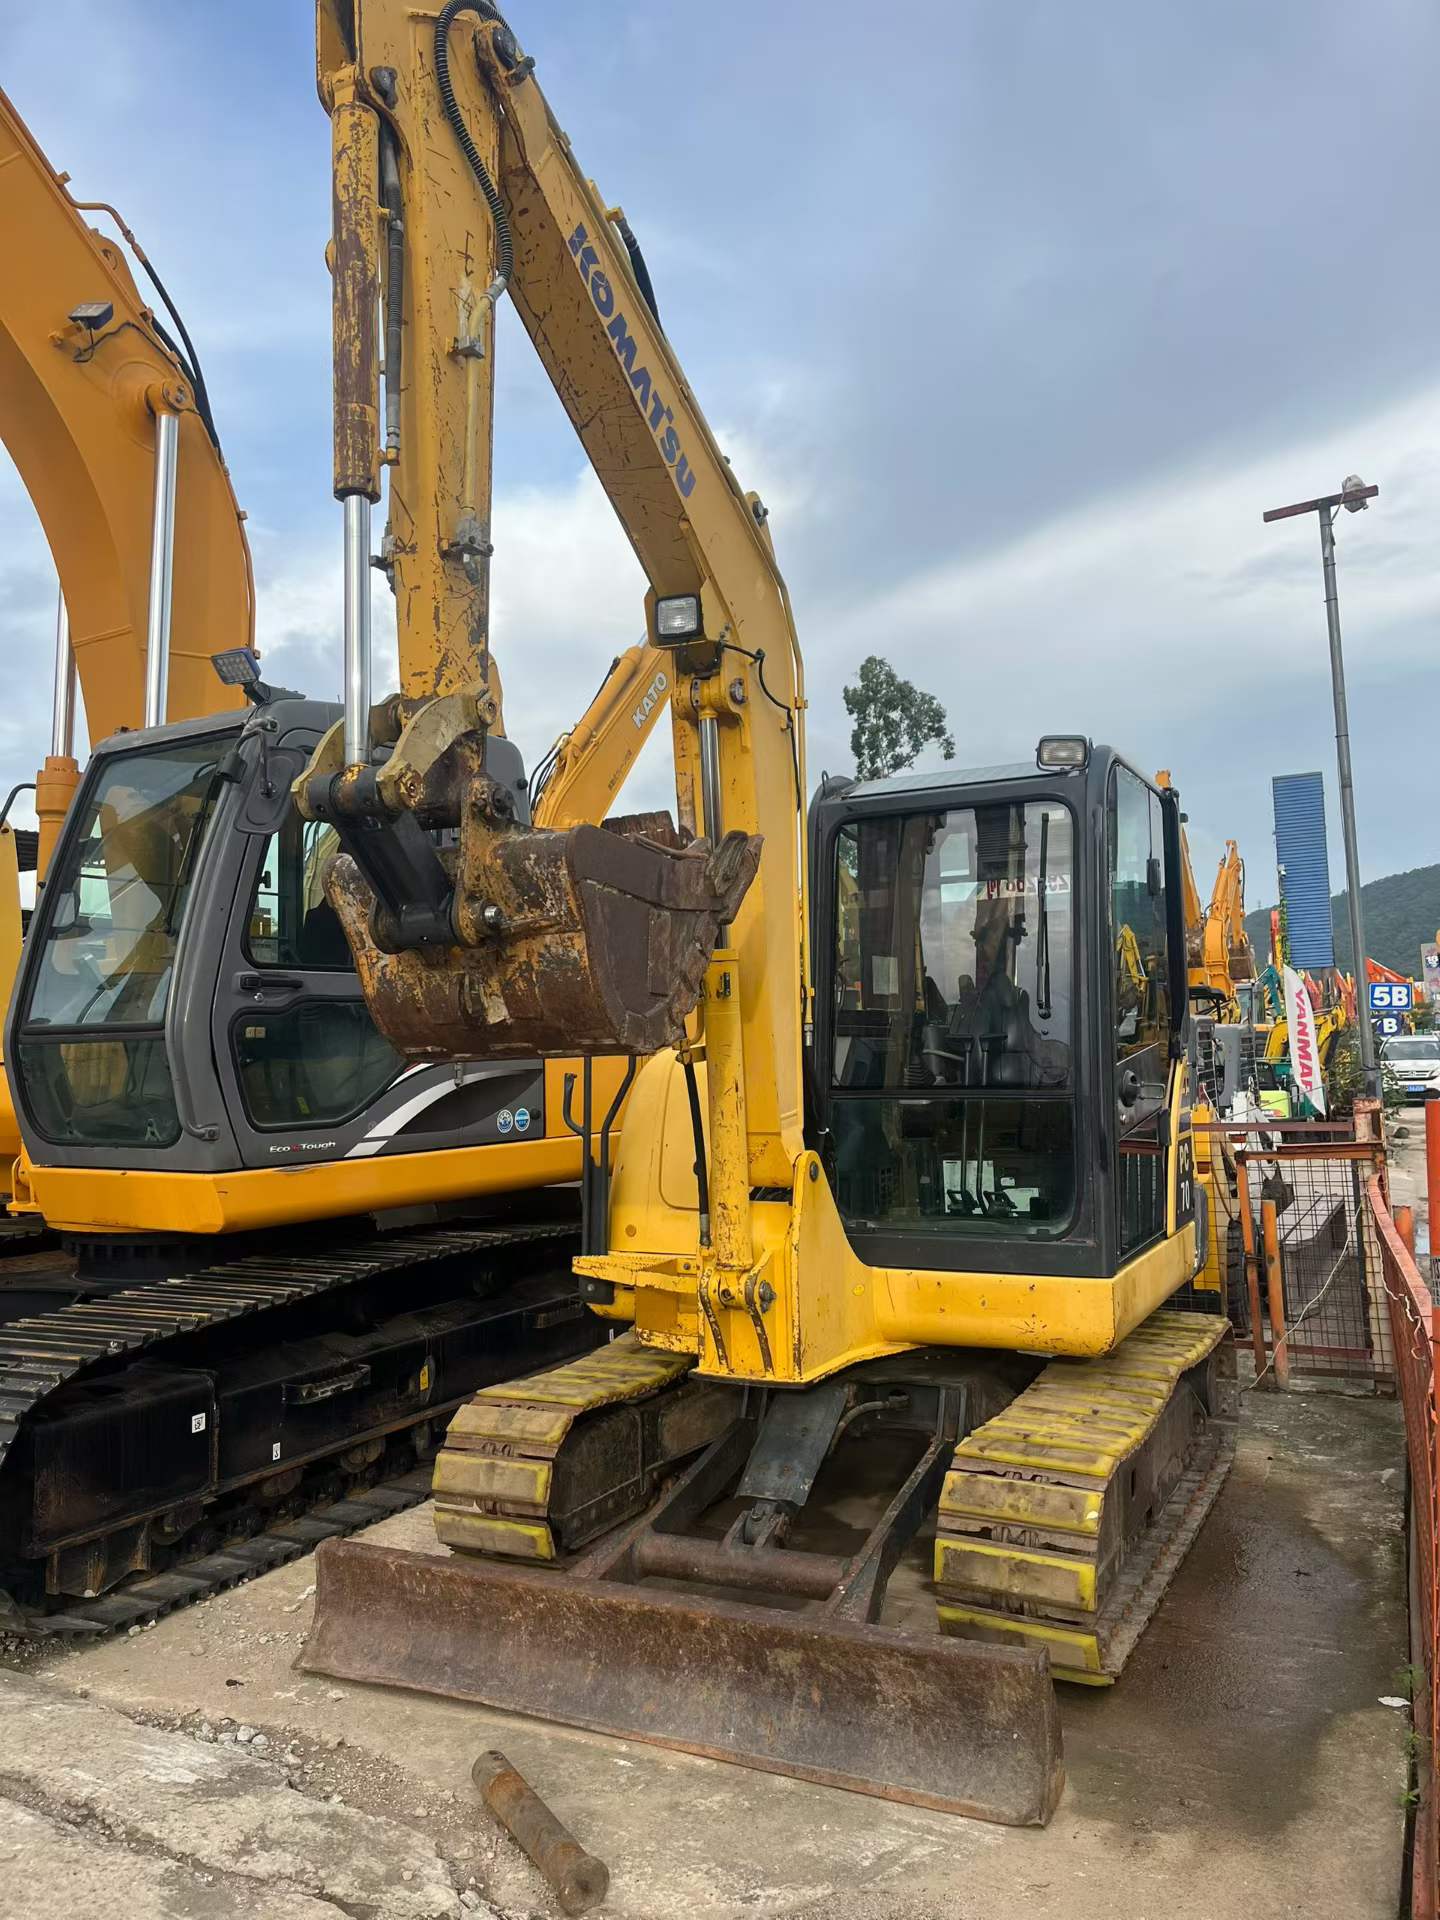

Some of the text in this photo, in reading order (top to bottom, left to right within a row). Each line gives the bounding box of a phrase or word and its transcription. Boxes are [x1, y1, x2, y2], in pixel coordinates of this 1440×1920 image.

[568, 222, 696, 498] KOMATSU
[632, 672, 667, 729] KATO
[1373, 986, 1409, 1007] 5B
[270, 1145, 290, 1153] Eco
[1179, 1143, 1190, 1174] PC
